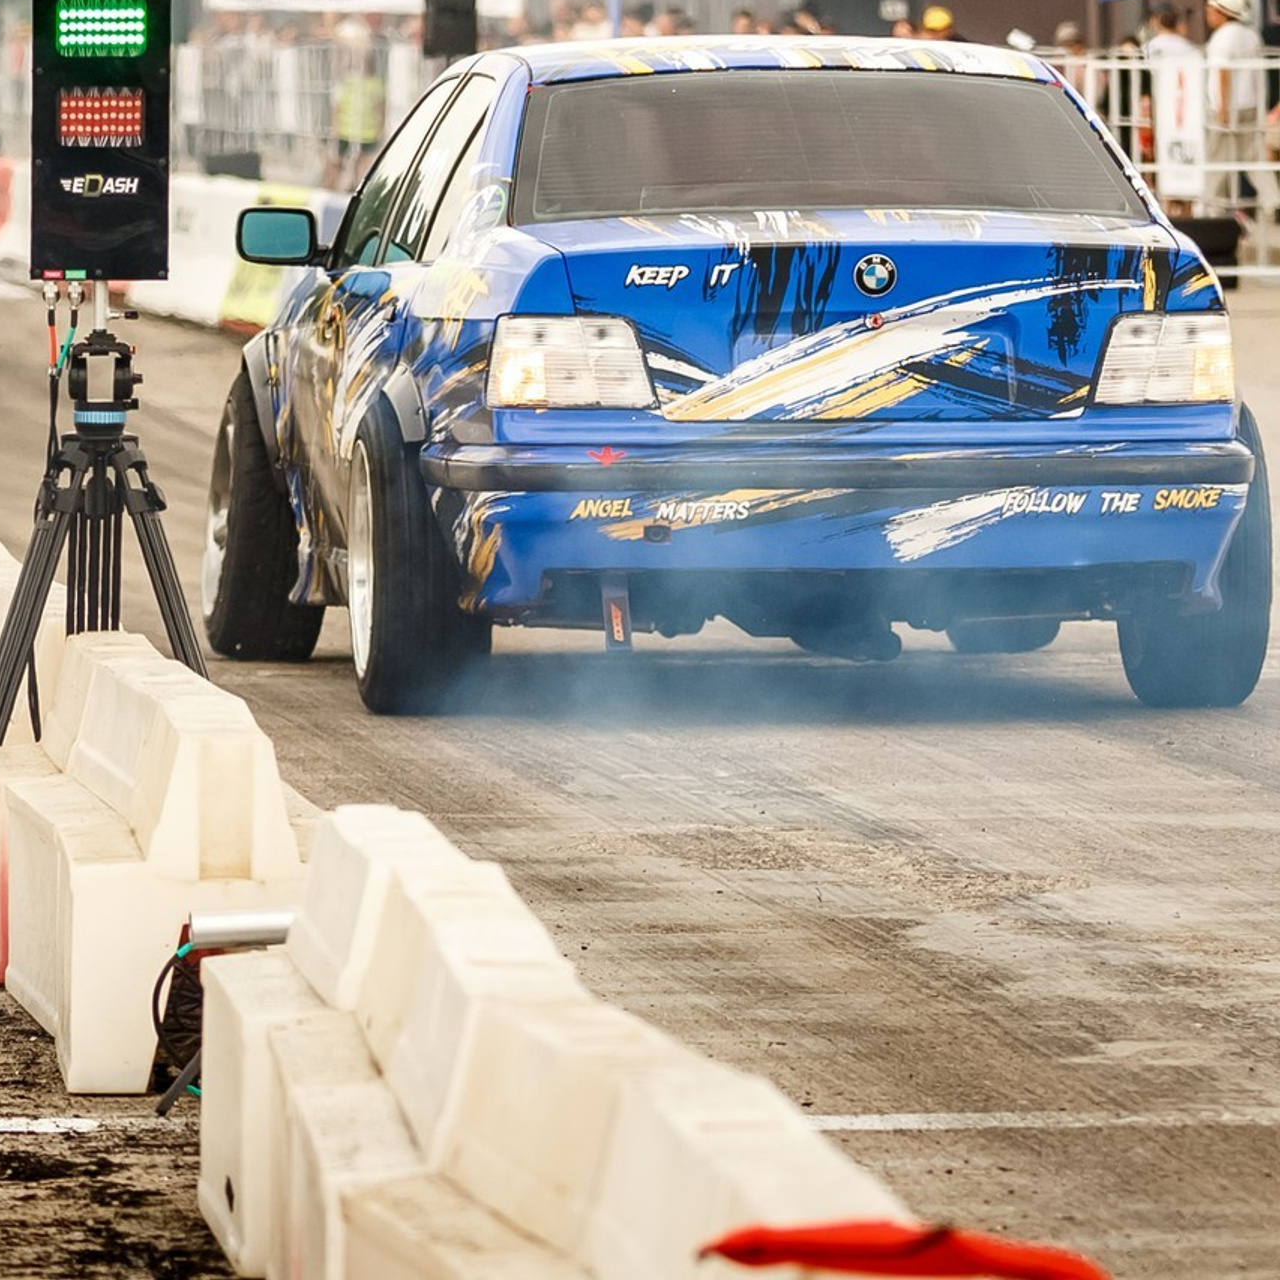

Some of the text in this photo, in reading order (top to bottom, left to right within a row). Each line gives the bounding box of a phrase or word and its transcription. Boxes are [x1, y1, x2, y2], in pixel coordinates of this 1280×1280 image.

[625, 263, 740, 288] KEEP IT
[569, 498, 751, 521] ANGEL MATTERS
[1002, 488, 1223, 514] FOLLOW THE SMOKE
